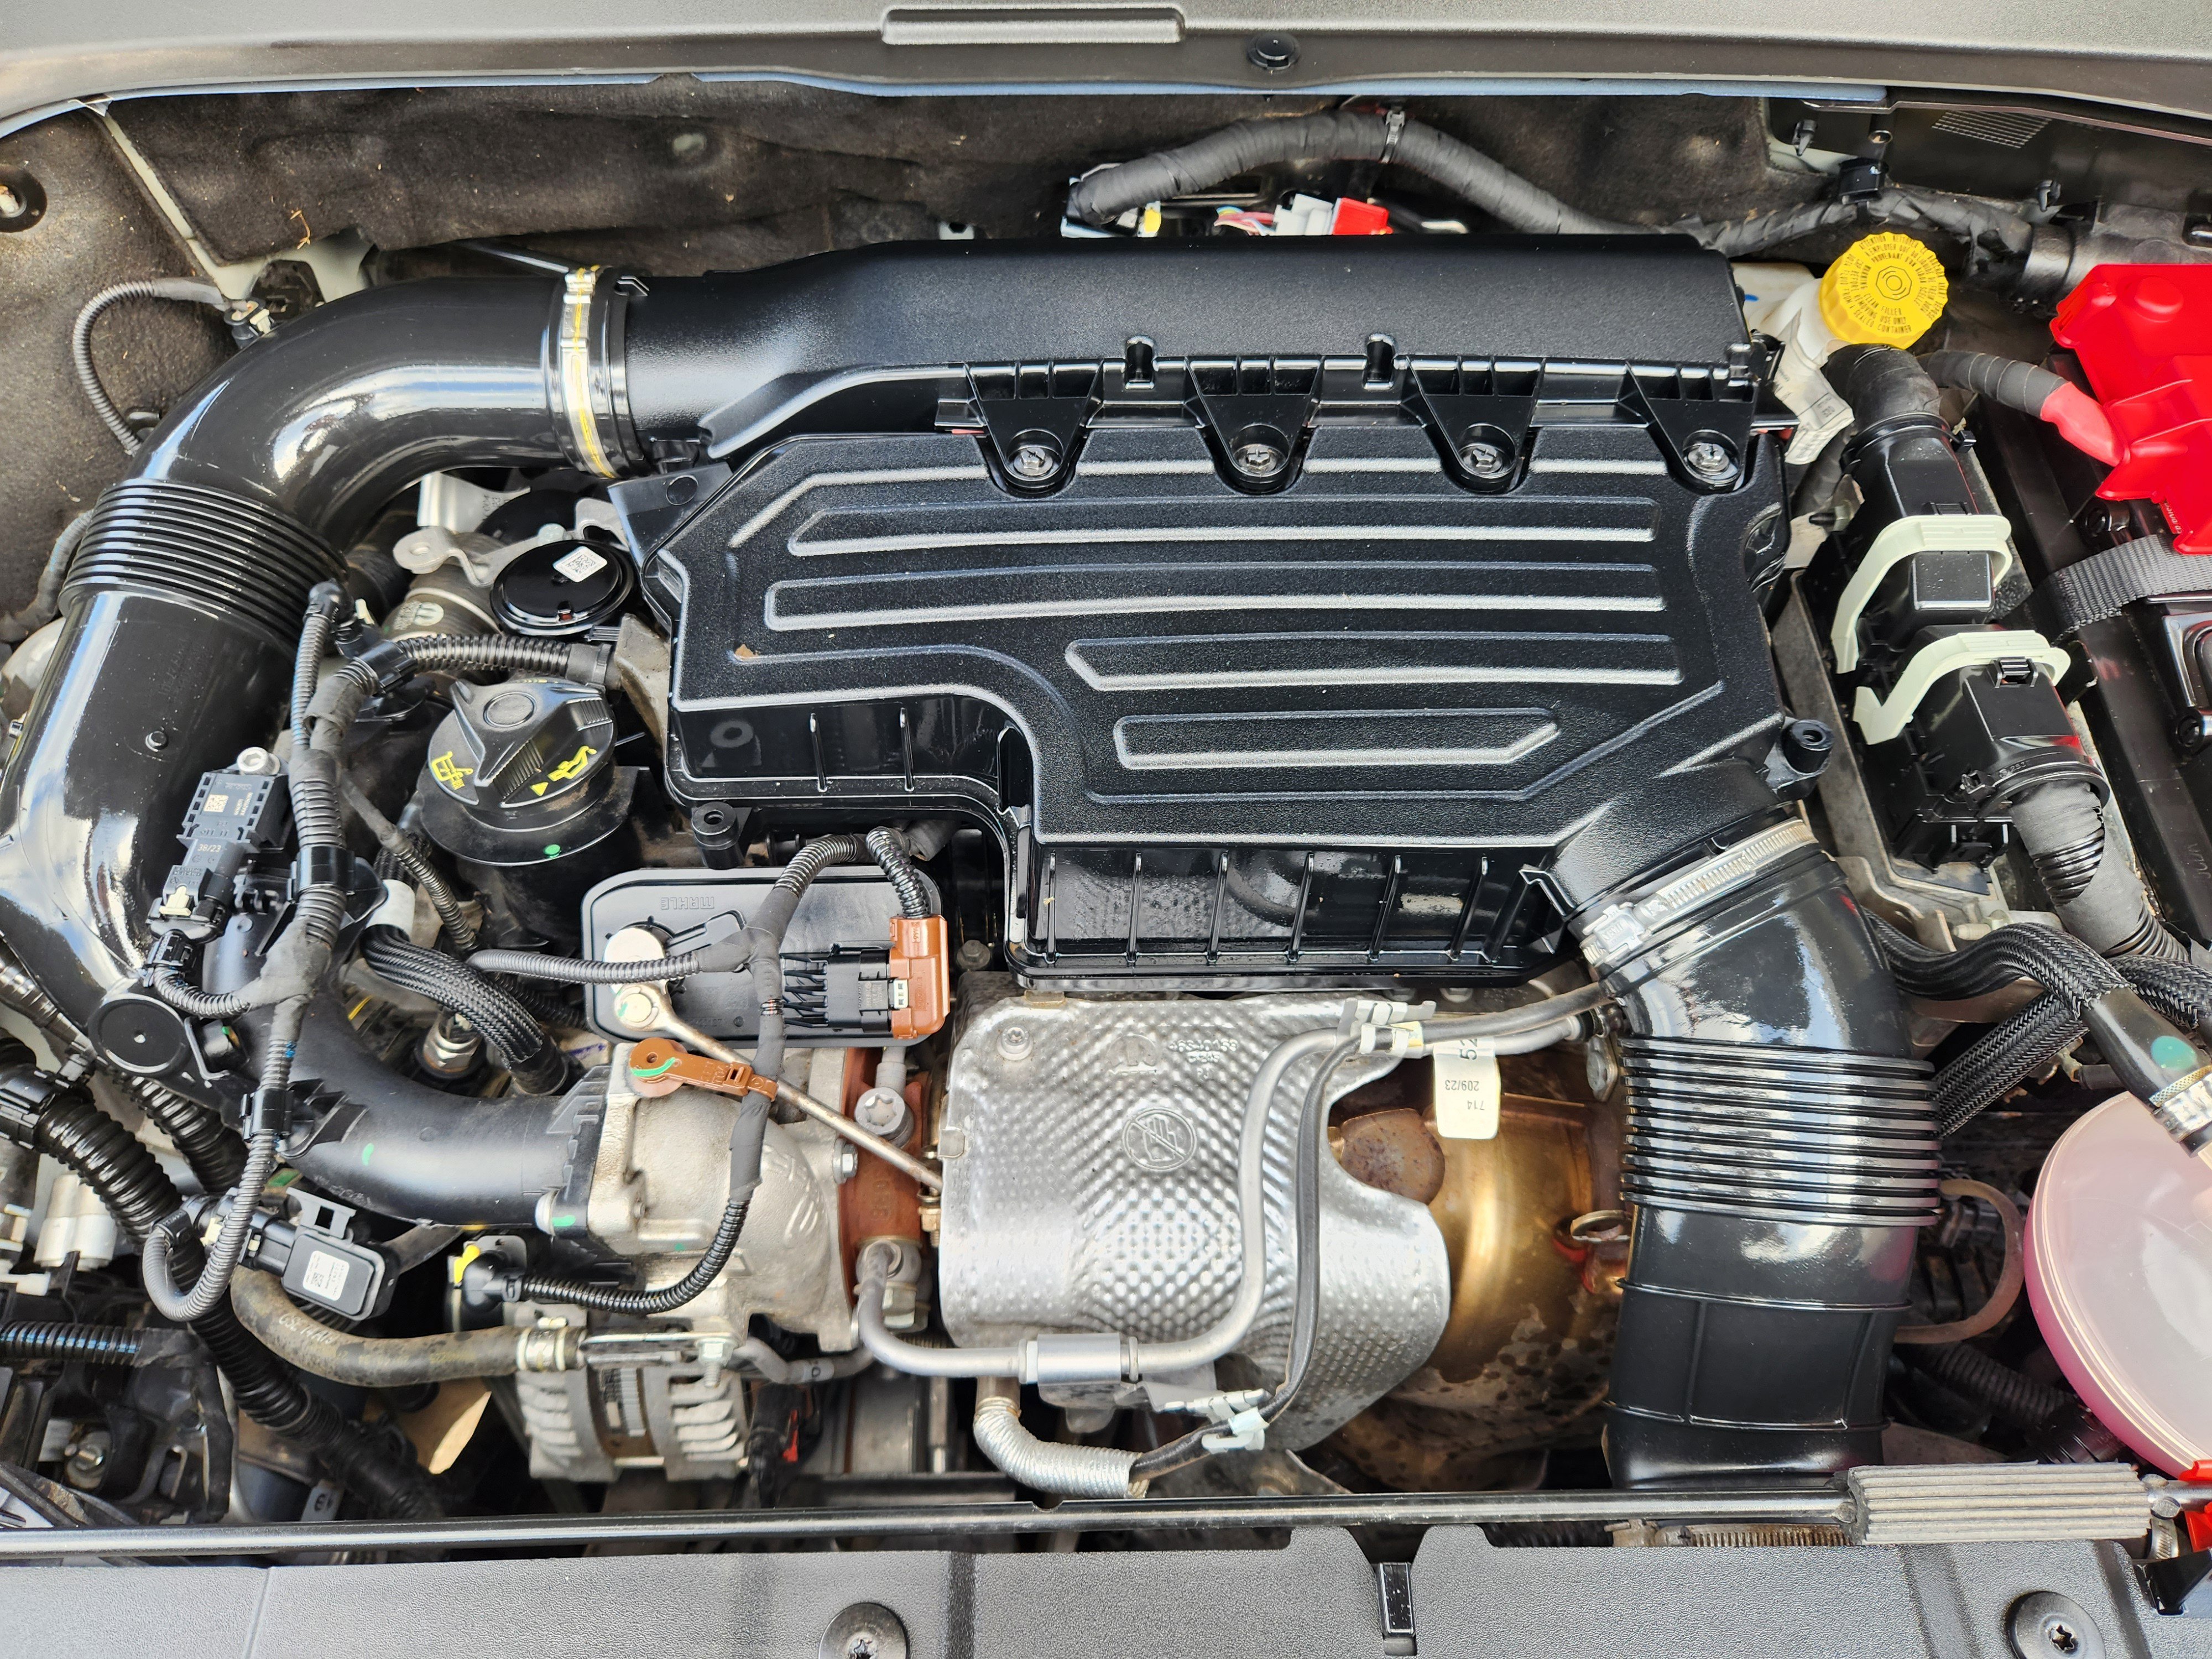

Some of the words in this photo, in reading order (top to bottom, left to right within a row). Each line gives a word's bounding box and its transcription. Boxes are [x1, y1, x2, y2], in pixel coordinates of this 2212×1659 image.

[1860, 265, 1871, 290] WARNING
[1863, 293, 1880, 309] CLEAN
[1854, 294, 1878, 319] REMOVING
[1880, 315, 1891, 325] USE
[1893, 317, 1906, 325] ONLY
[1880, 306, 1902, 316] FILLER
[1853, 309, 1875, 327] SEALED
[1877, 324, 1912, 333] CONTAINER
[197, 844, 221, 852] 38/23
[661, 896, 714, 910] MAHLE
[1444, 1079, 1479, 1091] 209/23
[1467, 1100, 1485, 1110] 714
